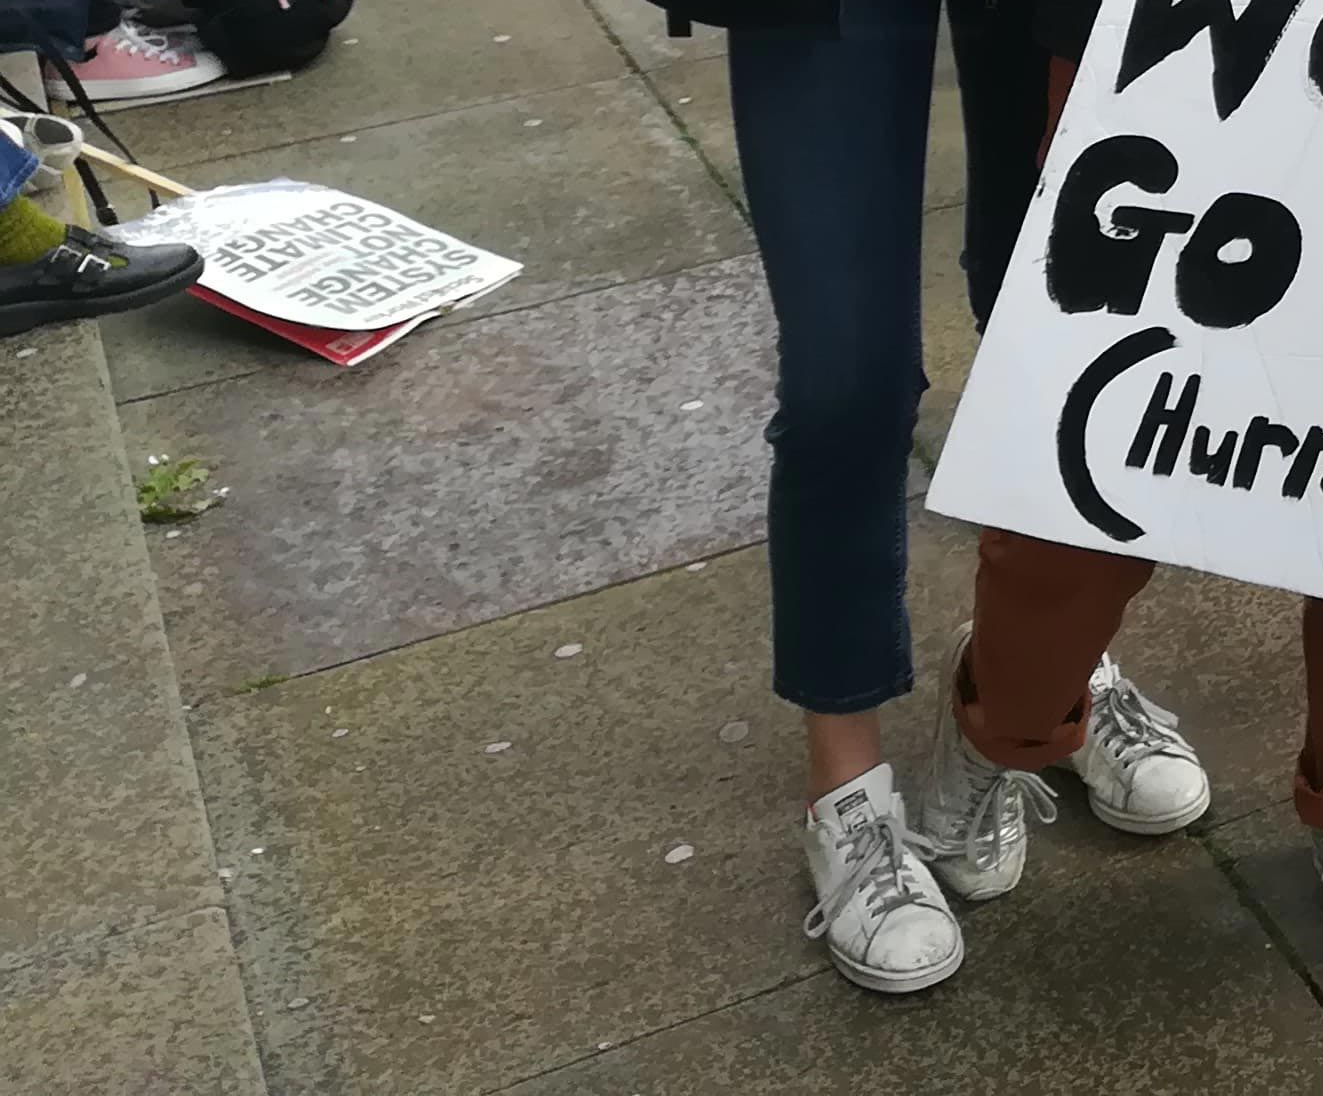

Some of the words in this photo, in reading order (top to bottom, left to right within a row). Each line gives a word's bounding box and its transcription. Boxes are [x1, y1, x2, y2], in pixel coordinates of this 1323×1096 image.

[204, 201, 365, 267] CHANGE
[225, 213, 393, 283] CLIMATE
[340, 224, 421, 260] NOT
[285, 237, 448, 306] CHANGE
[323, 249, 478, 314] SYSTEM
